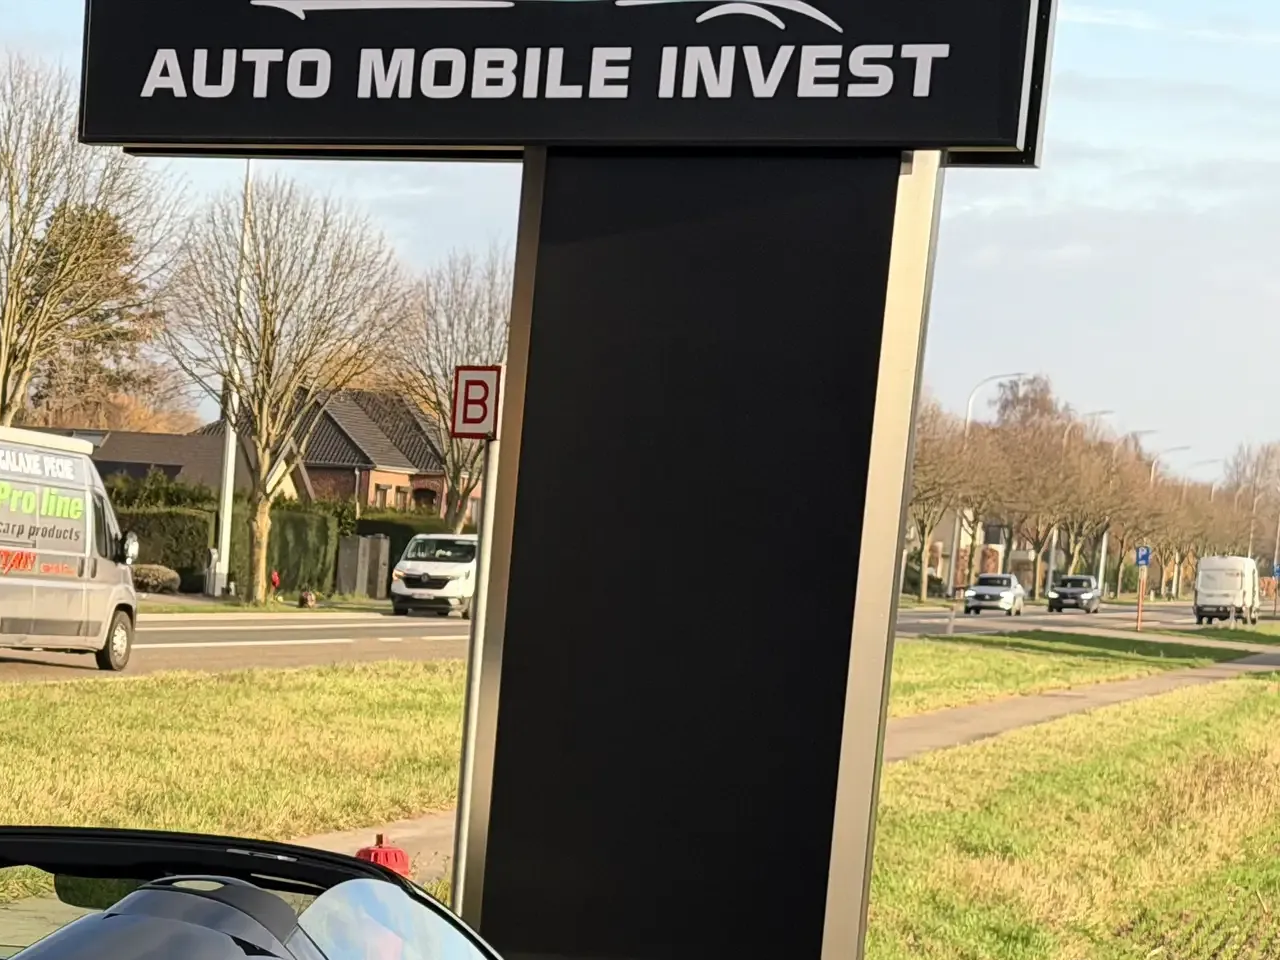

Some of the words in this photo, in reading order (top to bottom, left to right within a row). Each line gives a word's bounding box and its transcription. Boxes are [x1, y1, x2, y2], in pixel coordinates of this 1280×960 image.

[140, 47, 331, 99] AUTO
[357, 45, 632, 99] MOBILE
[657, 43, 950, 99] INVEST
[462, 379, 489, 424] B
[41, 487, 84, 519] line
[28, 525, 81, 541] products
